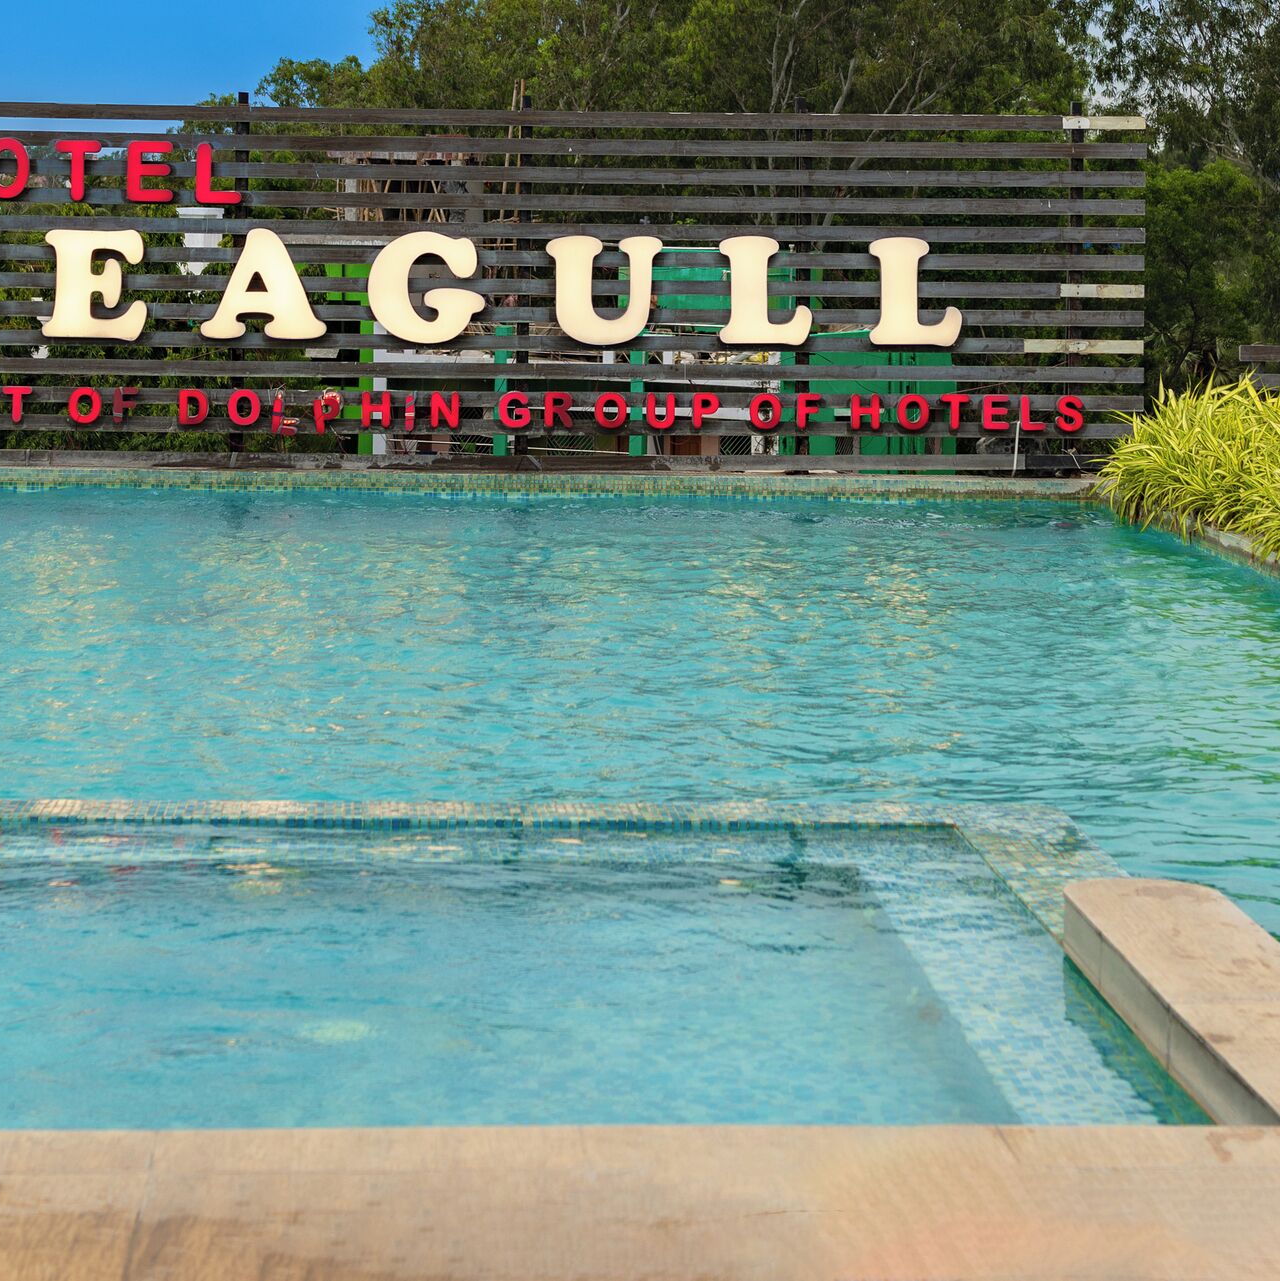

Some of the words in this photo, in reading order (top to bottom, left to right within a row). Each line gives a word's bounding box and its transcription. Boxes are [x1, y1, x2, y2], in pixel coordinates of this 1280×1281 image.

[68, 386, 139, 425] OF
[178, 386, 460, 436] DOLPHIN
[498, 391, 720, 429] GROUP
[749, 392, 822, 430] OF
[850, 393, 1085, 432] HOTELS
